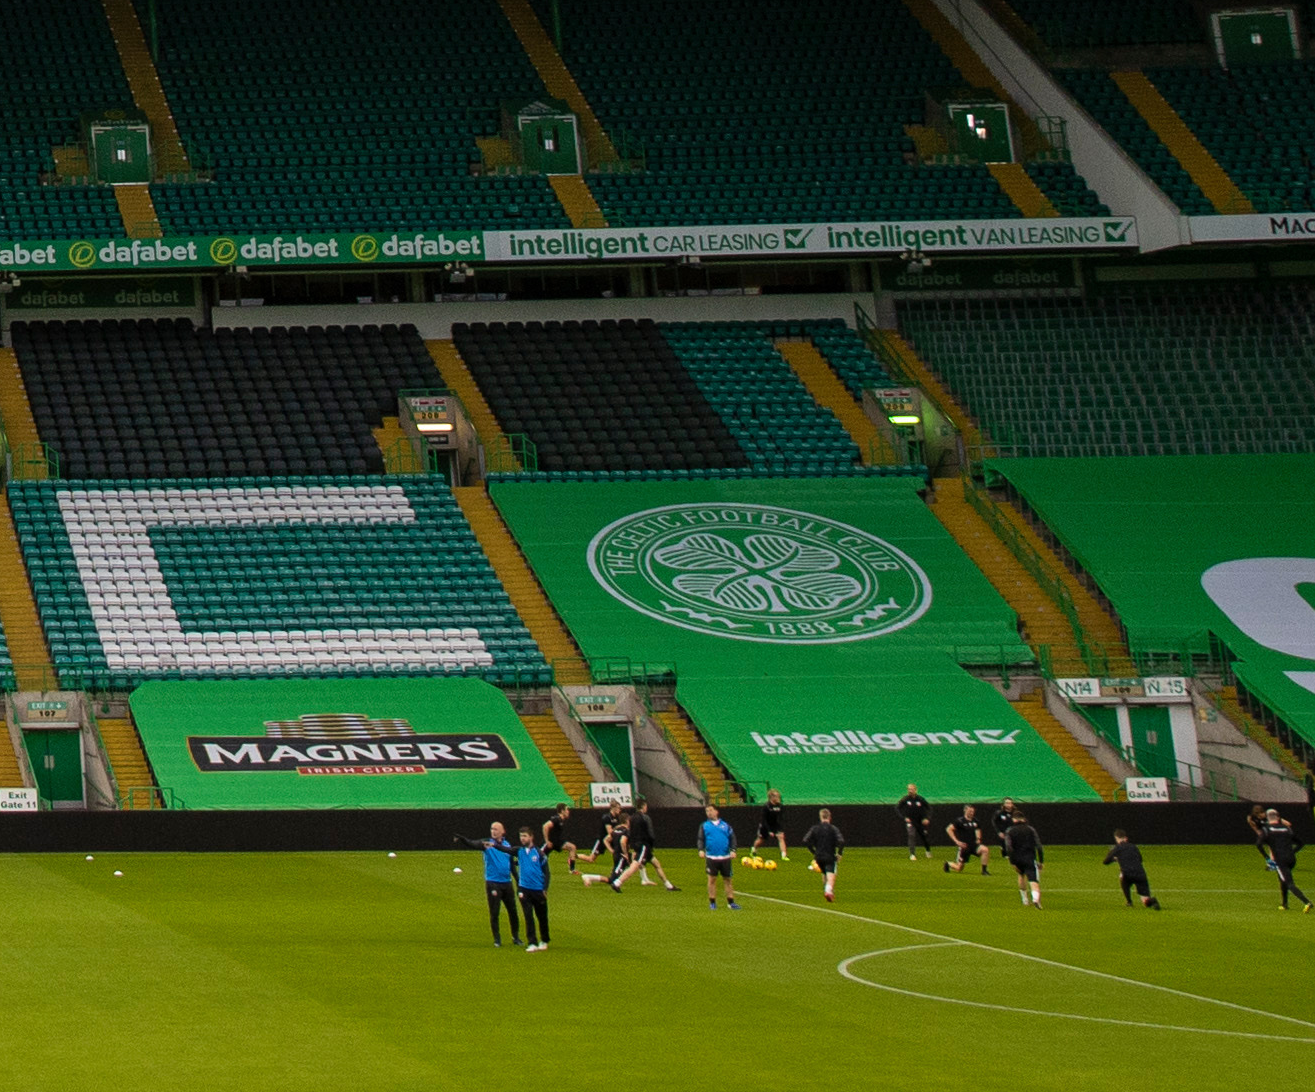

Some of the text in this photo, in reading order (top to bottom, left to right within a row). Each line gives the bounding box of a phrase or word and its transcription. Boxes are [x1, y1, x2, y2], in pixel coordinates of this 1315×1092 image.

[382, 233, 481, 260] dafabet
[510, 231, 780, 259] intelligent CAR LEASING
[827, 224, 1100, 250] intelligent VAN LEASING
[98, 240, 197, 267] dafabet
[240, 236, 338, 264] dafabet
[21, 291, 85, 307] dafabet
[114, 289, 179, 305] dafabet
[605, 510, 901, 577] THE CELTIC FOOTBALL CLUB
[765, 621, 836, 636] 1888
[750, 729, 978, 751] intelligent
[761, 745, 880, 754] CAR LEASING
[202, 741, 499, 764] MAGNERS
[362, 766, 415, 774] CIDER
[601, 786, 621, 794] Exit
[620, 796, 631, 804] 12
